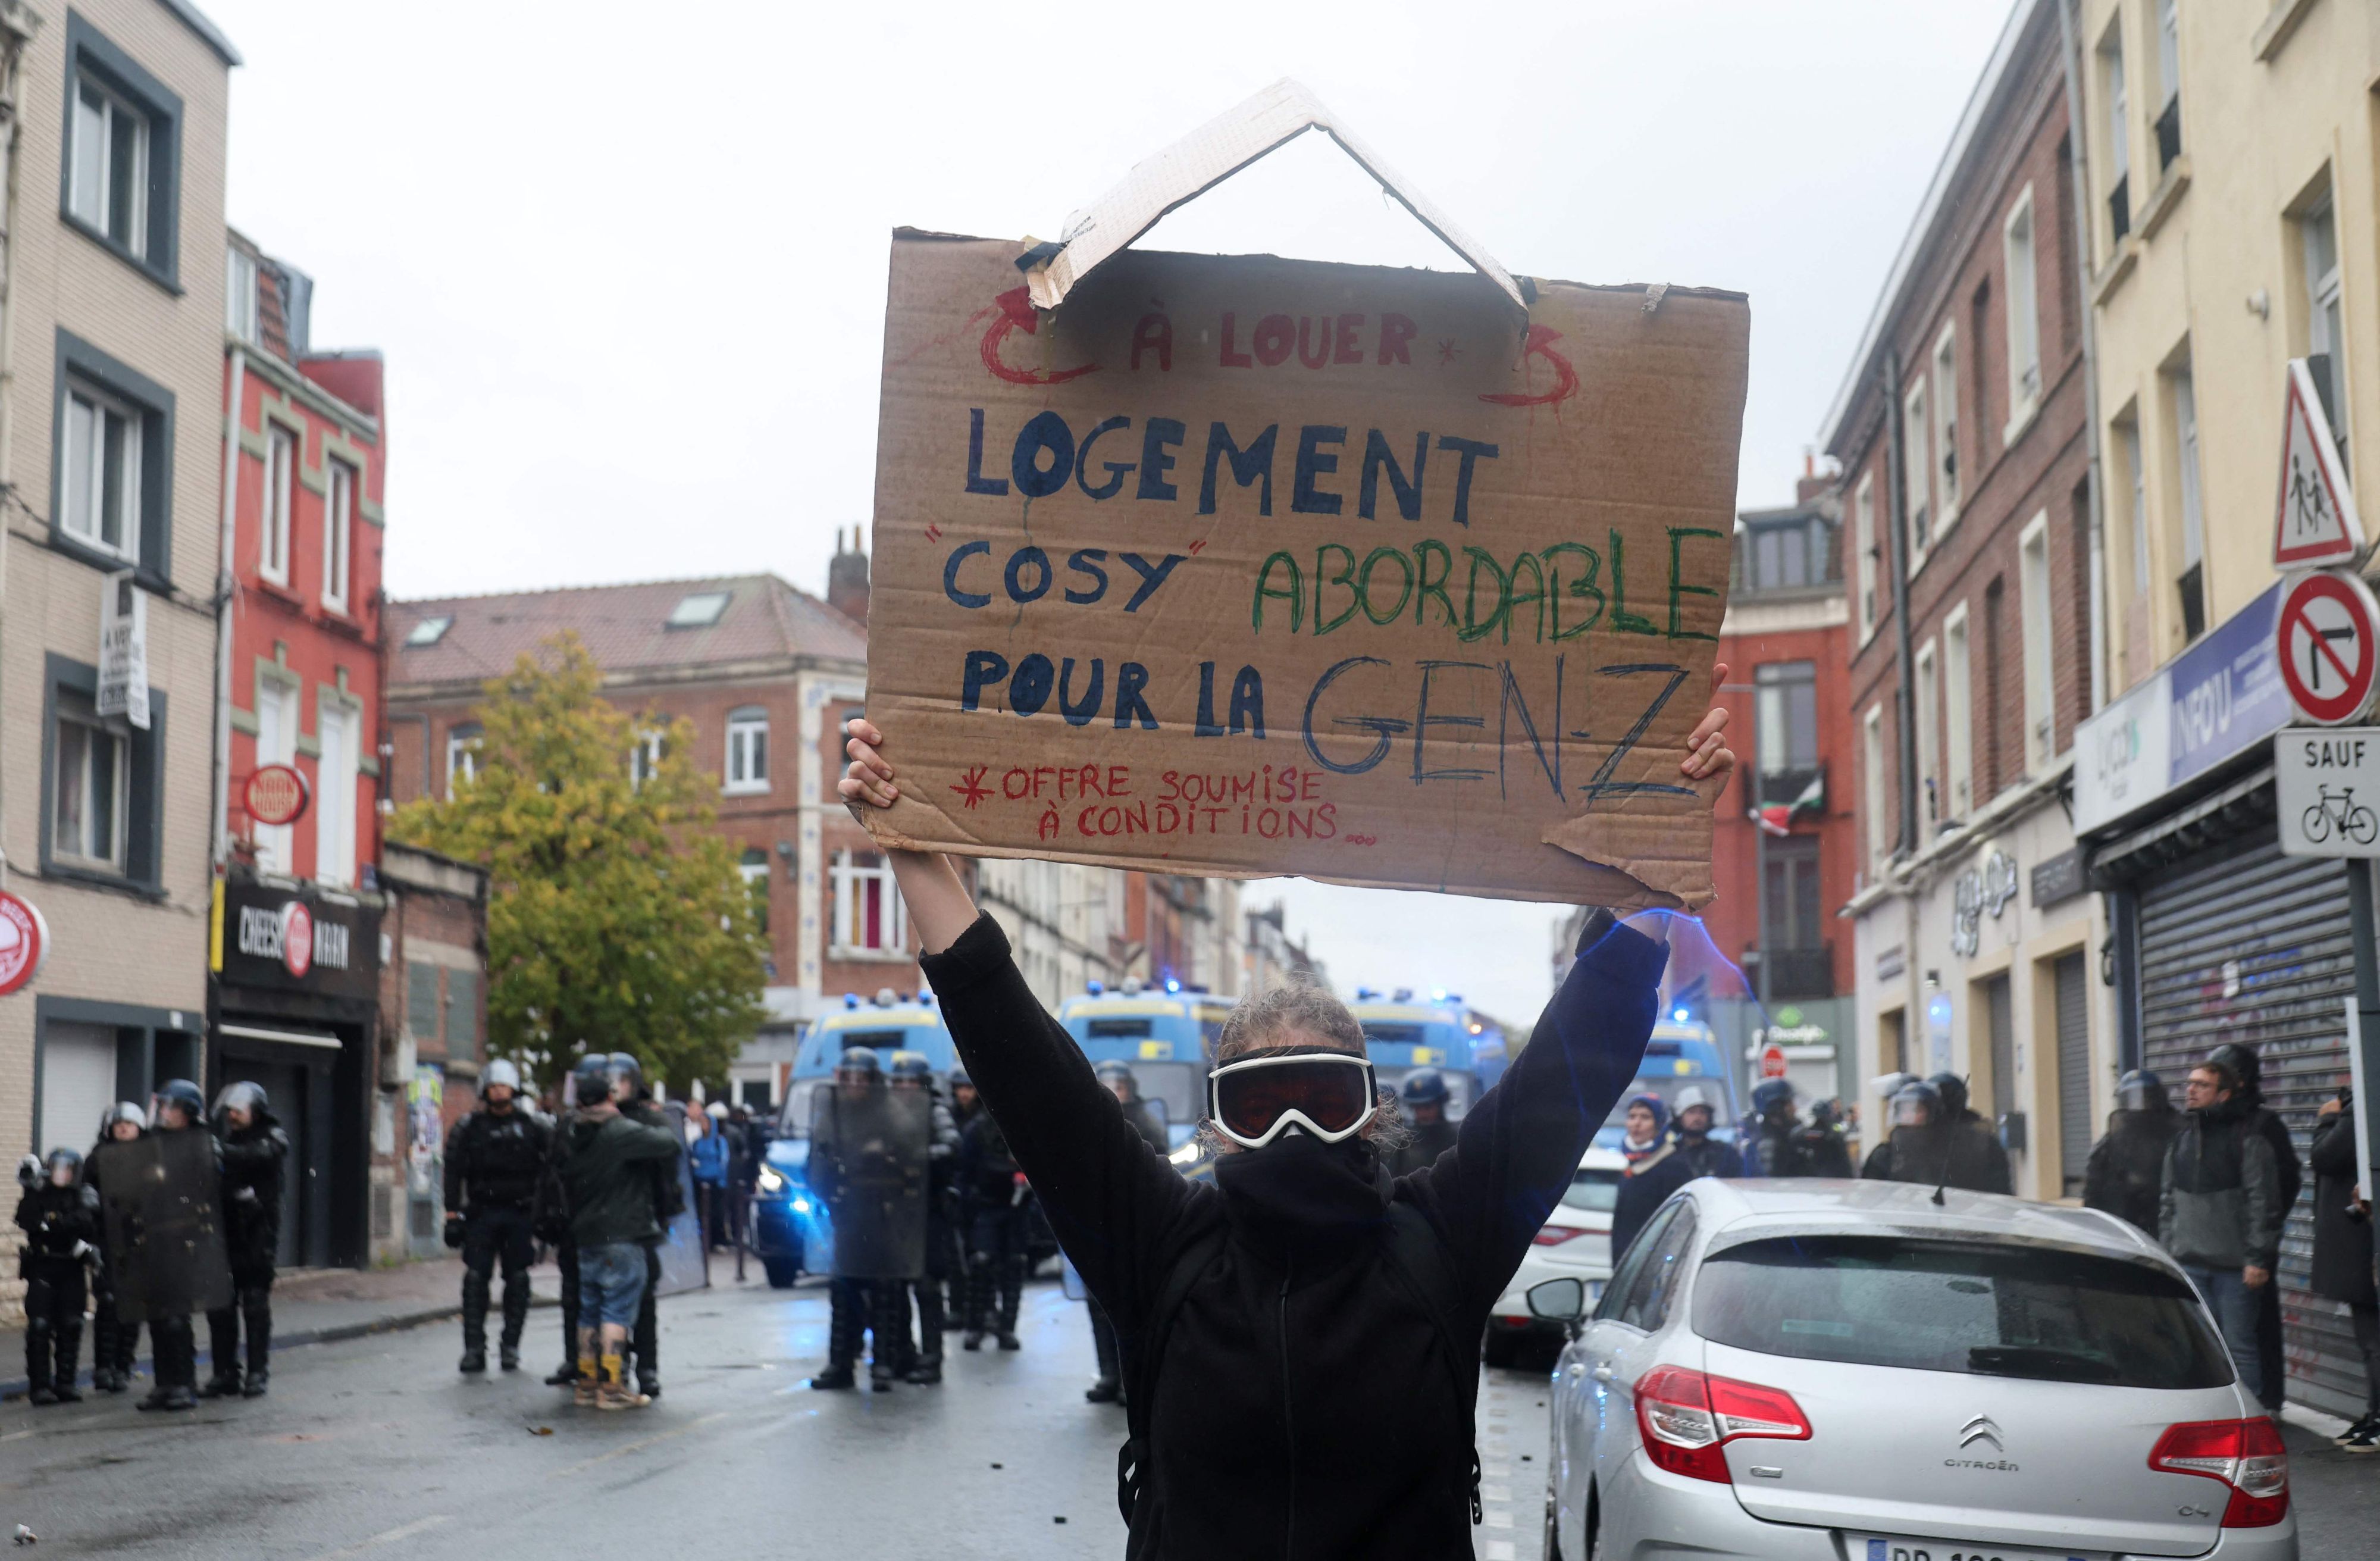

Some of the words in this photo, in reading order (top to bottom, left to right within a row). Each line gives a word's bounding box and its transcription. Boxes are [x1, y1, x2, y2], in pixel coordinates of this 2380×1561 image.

[1130, 302, 1173, 371] À
[1219, 312, 1418, 370] LOUER
[964, 408, 1499, 529] LOGEMENT
[1252, 525, 1724, 645] ABORDABLE
[962, 650, 1160, 730] POUR
[1194, 661, 1266, 739] LA
[2305, 741, 2366, 768] SAUF
[1039, 800, 1060, 841] À
[1944, 1459, 2019, 1471] CITROËN
